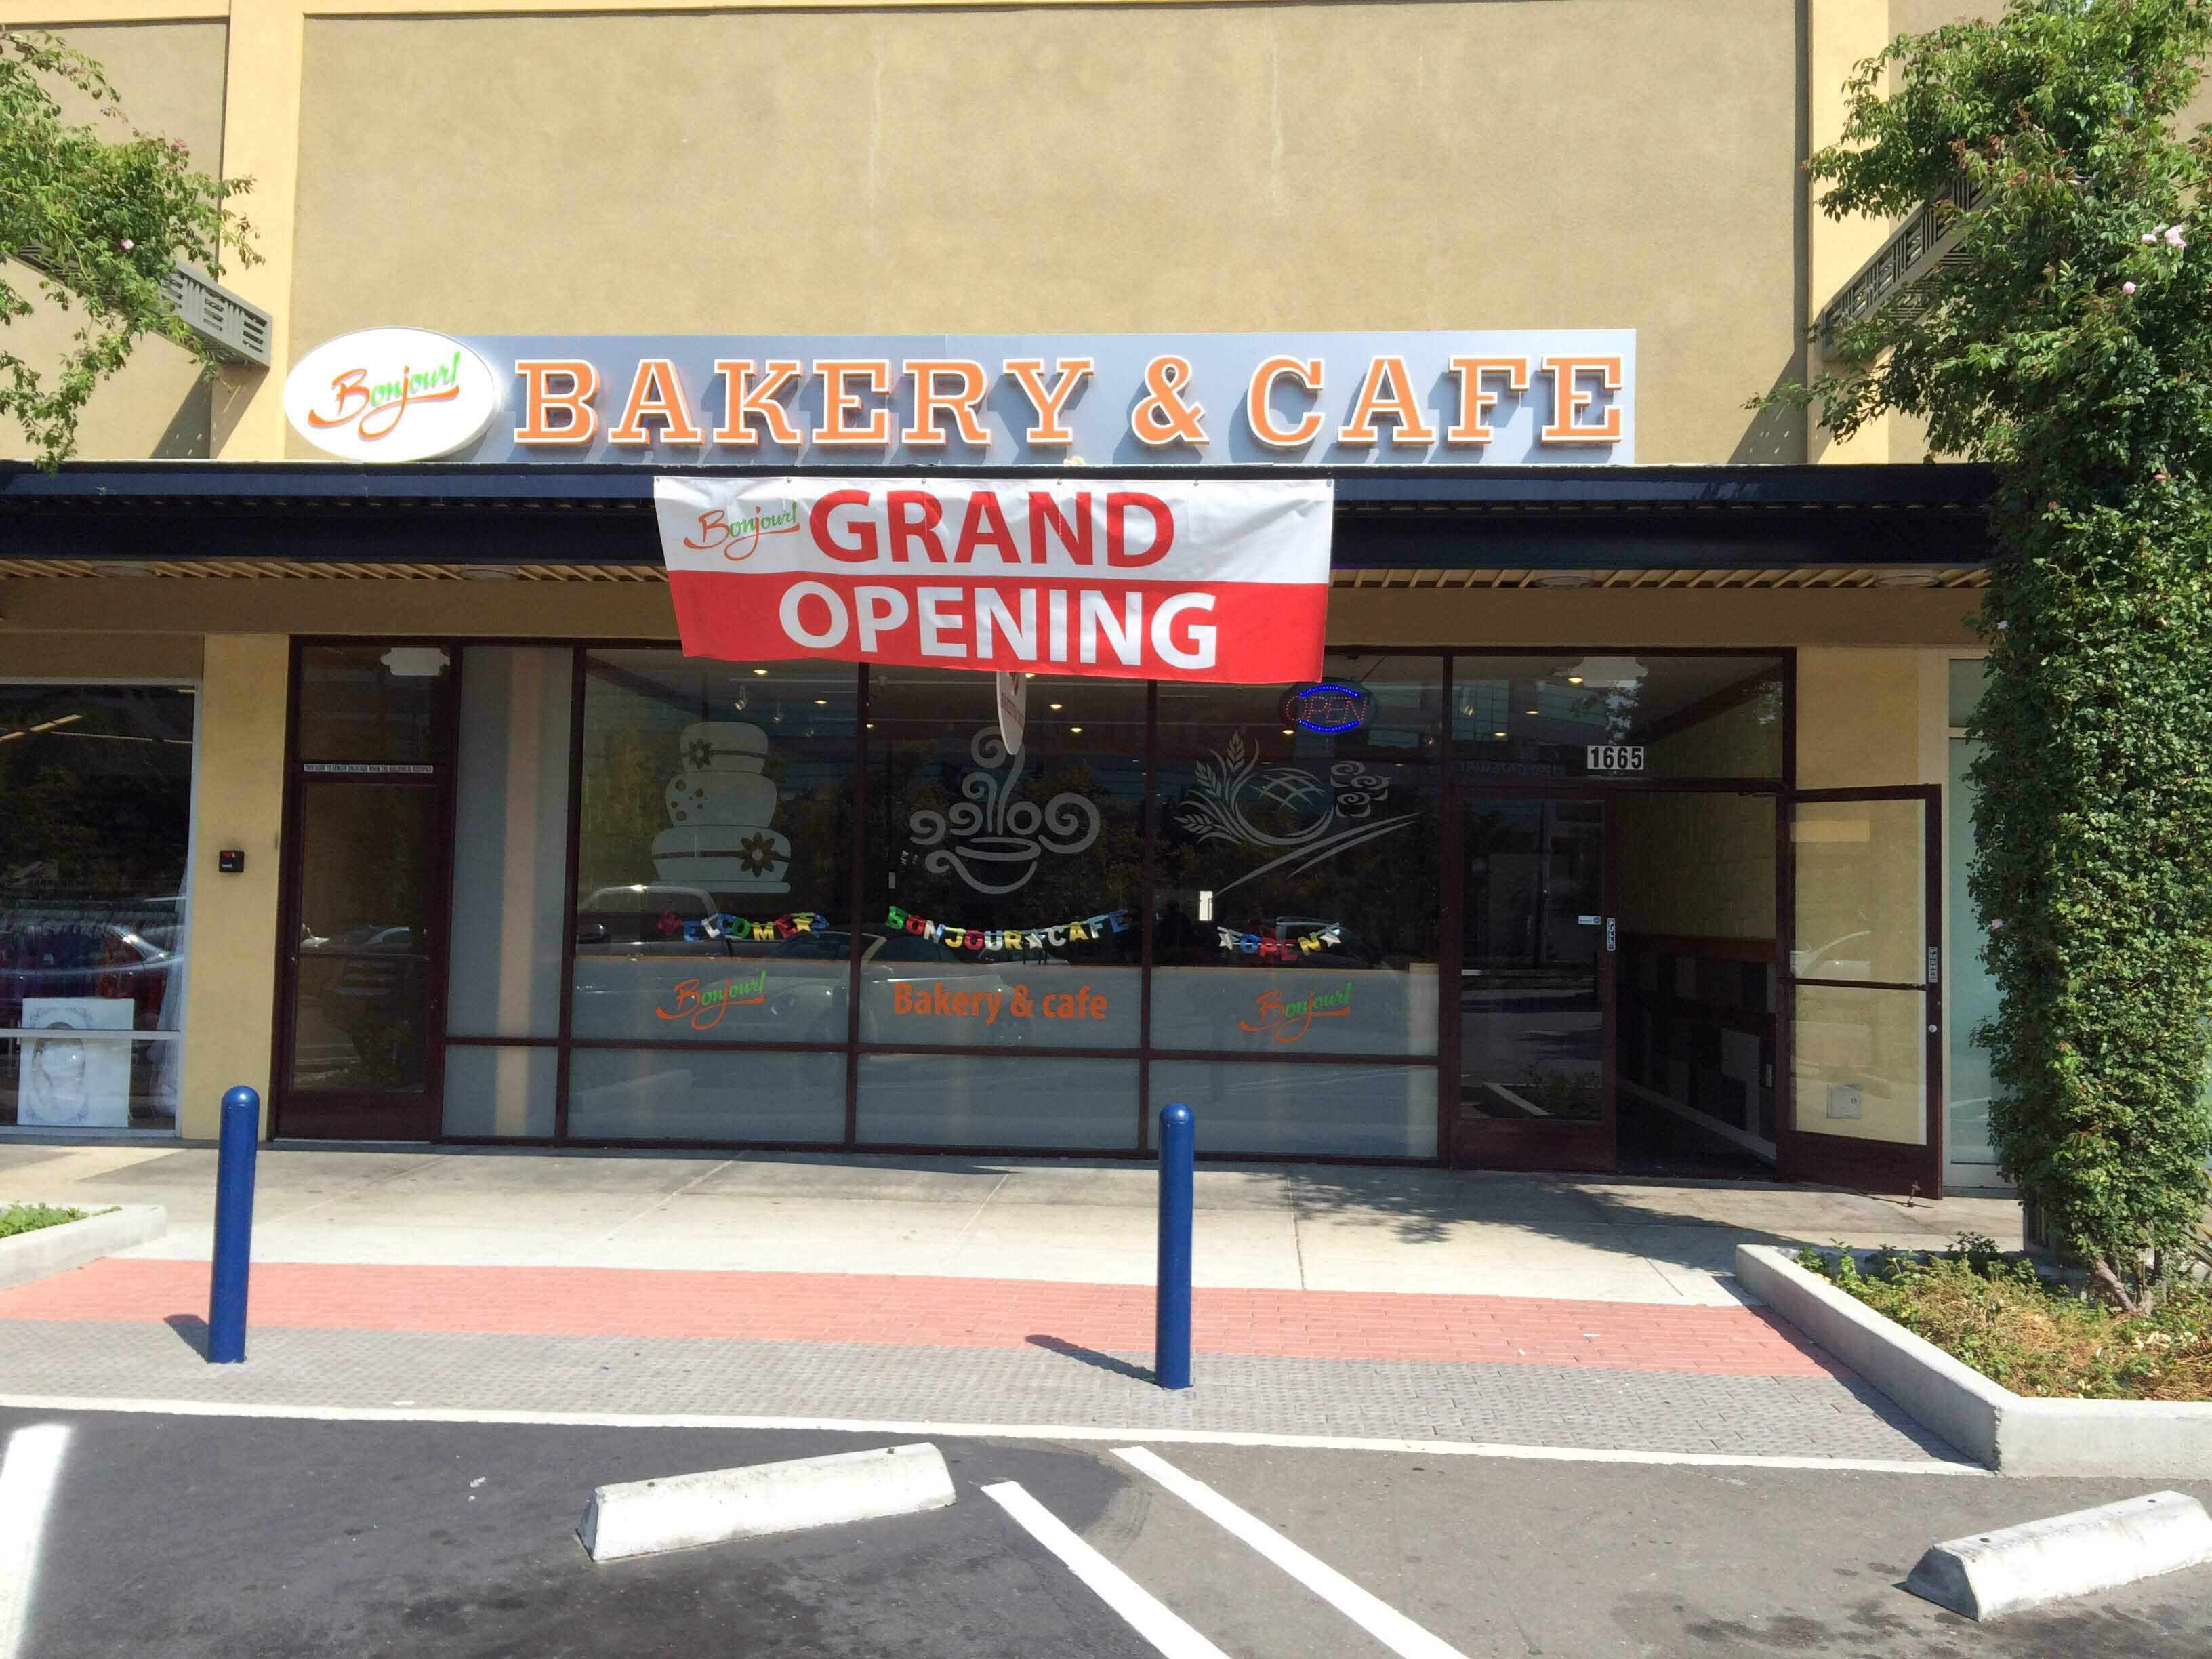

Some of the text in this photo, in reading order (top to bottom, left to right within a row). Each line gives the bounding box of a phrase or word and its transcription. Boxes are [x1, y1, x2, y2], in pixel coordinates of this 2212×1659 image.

[514, 354, 1624, 448] BAKERY & CAFE
[809, 489, 1176, 568] GRAND
[779, 580, 1218, 670] OPENING
[1285, 694, 1368, 724] OPEN
[1589, 747, 1643, 769] 1665
[1048, 908, 1128, 947] CAFE
[893, 980, 1108, 1026] Bakery & cafe
